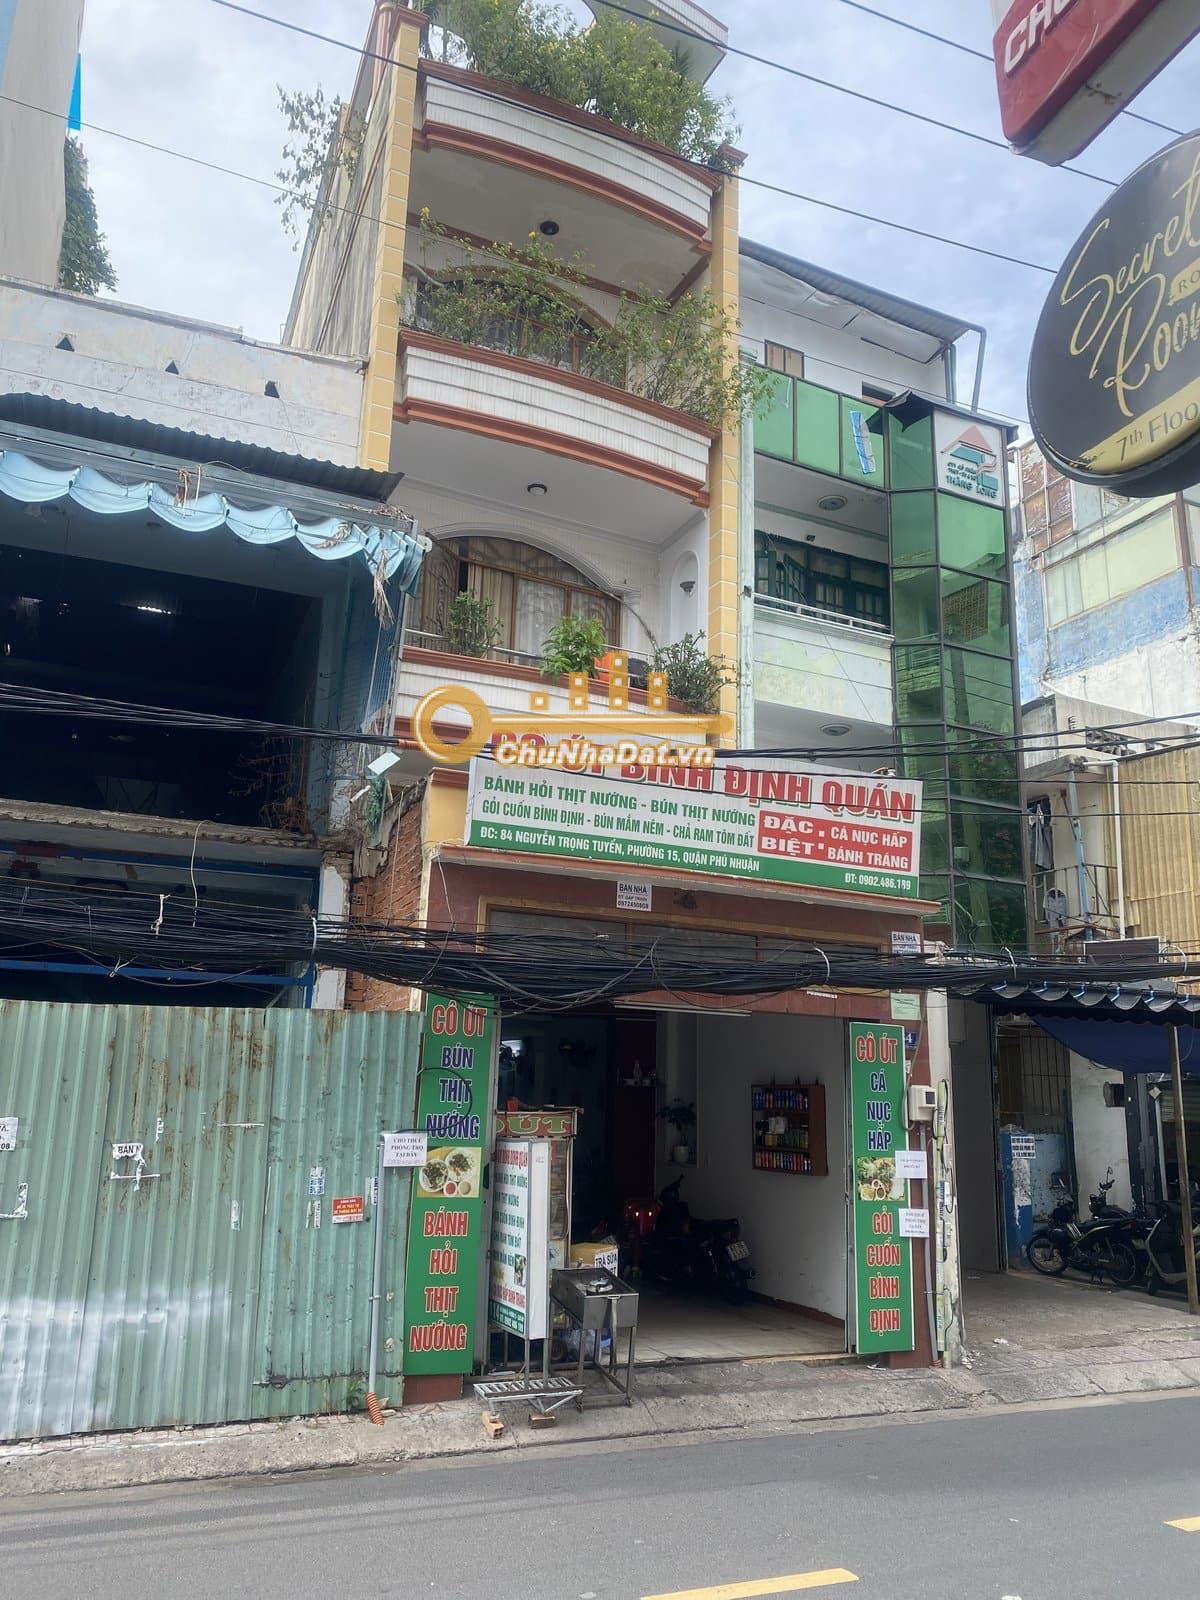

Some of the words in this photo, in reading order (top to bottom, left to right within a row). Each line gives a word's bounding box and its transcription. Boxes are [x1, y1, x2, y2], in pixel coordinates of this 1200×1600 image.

[1116, 428, 1143, 461] 7th
[484, 776, 525, 796] BÁNH
[529, 780, 553, 799] HỎI
[557, 787, 587, 805] THỊT
[590, 790, 637, 811] NƯỚNG
[650, 798, 678, 816] BÚN
[682, 804, 709, 822] THỊT
[712, 809, 756, 827] NƯỚNG
[724, 765, 812, 807] ĐỊNH
[822, 782, 914, 822] QUÁN
[482, 796, 500, 815] GỎI
[503, 800, 531, 819] CUỐN
[533, 804, 558, 822] BÌNH
[560, 810, 585, 829] ĐỊNH
[594, 812, 614, 830] BÚN
[616, 814, 640, 833] MẮM
[643, 819, 664, 836] NÊM
[673, 822, 691, 840] CHẢ
[693, 827, 714, 843] RAM
[716, 829, 735, 845] TÔM
[737, 830, 754, 848] ĐẤT
[763, 815, 814, 834] ĐẶC
[830, 825, 848, 841] CÁ
[852, 830, 878, 847] NỤC
[882, 831, 907, 848] HẤP
[480, 826, 498, 840] ĐC:
[500, 829, 513, 841] 84
[515, 831, 556, 847] NGUYỄN
[558, 836, 589, 851] TRỌNG
[627, 844, 664, 860] PHƯỜNG
[667, 849, 680, 863] 15,
[683, 851, 708, 866] QUẬN
[709, 854, 727, 867] PHÚ
[729, 857, 760, 873] NHUẬN
[761, 836, 815, 856] BIỆT
[828, 846, 863, 864] BÁNH
[867, 852, 909, 869] TRÁNG
[845, 872, 857, 884] ĐT:
[858, 874, 911, 890] 0902.486.189
[431, 1000, 458, 1035] CÔ
[463, 1001, 487, 1037] ÚT
[441, 1043, 474, 1069] BÚN
[856, 1032, 876, 1063] CÔ
[879, 1033, 897, 1063] ÚT
[440, 1078, 472, 1108] THỊT
[870, 1068, 887, 1092] CÁ
[425, 1109, 480, 1139] NƯỚNG
[866, 1101, 892, 1125] NỤC
[867, 1123, 892, 1151] HẤP
[423, 1206, 469, 1237] BÁNH
[872, 1205, 894, 1235] GỎI
[429, 1240, 458, 1274] HỎI
[866, 1236, 901, 1267] CUỐN
[869, 1271, 900, 1299] BÌNH
[424, 1286, 459, 1318] THỊT
[409, 1319, 468, 1352] NƯỚNG
[870, 1308, 901, 1337] ĐỊNH
